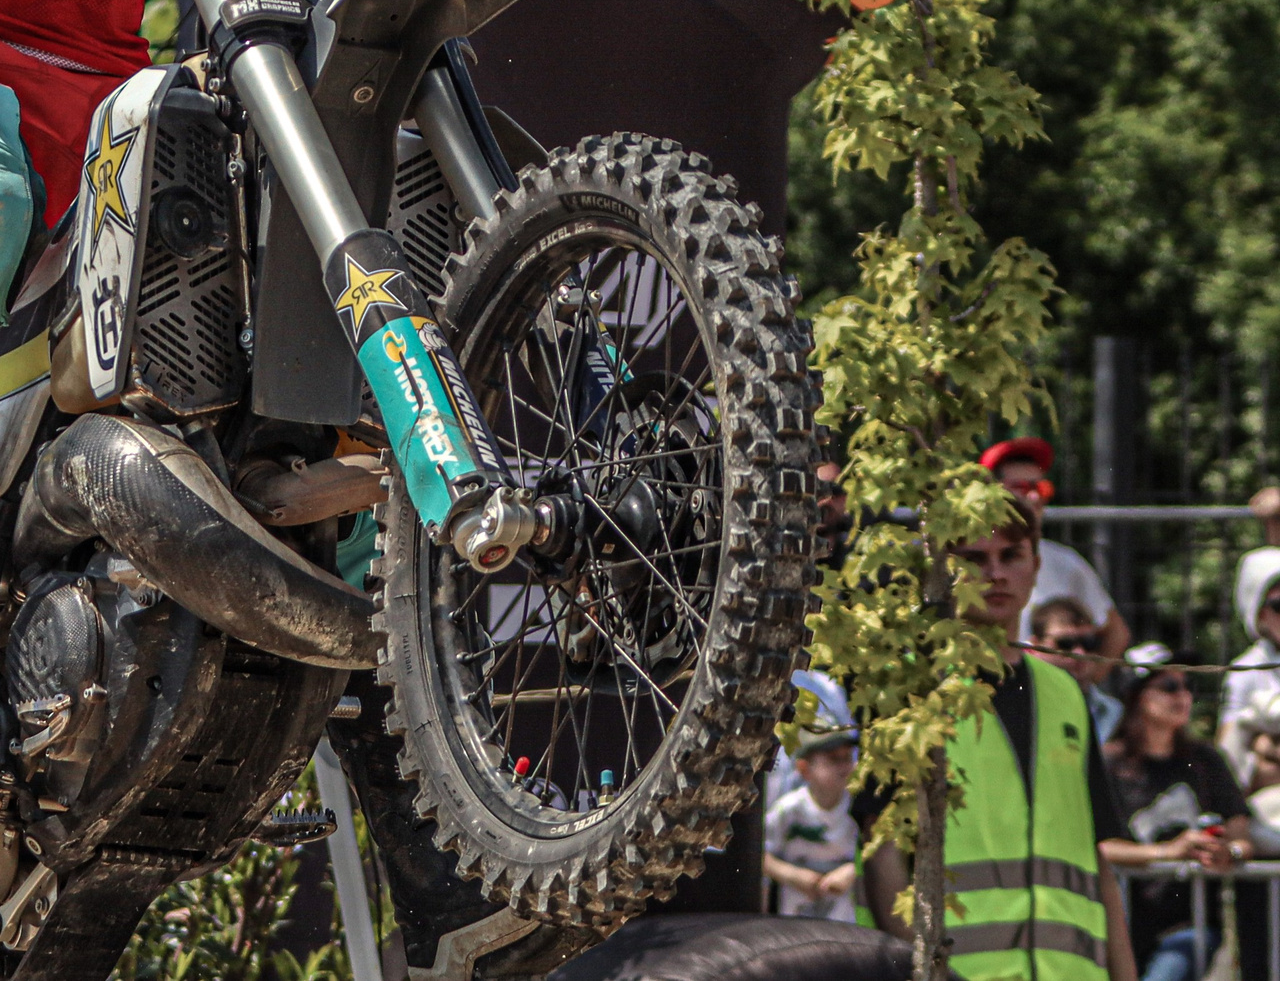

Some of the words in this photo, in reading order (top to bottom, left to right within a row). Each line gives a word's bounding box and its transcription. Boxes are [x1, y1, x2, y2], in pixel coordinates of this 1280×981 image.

[580, 194, 638, 222] MICHELIN
[539, 226, 572, 252] EXCEL
[438, 354, 500, 469] MICHELIN
